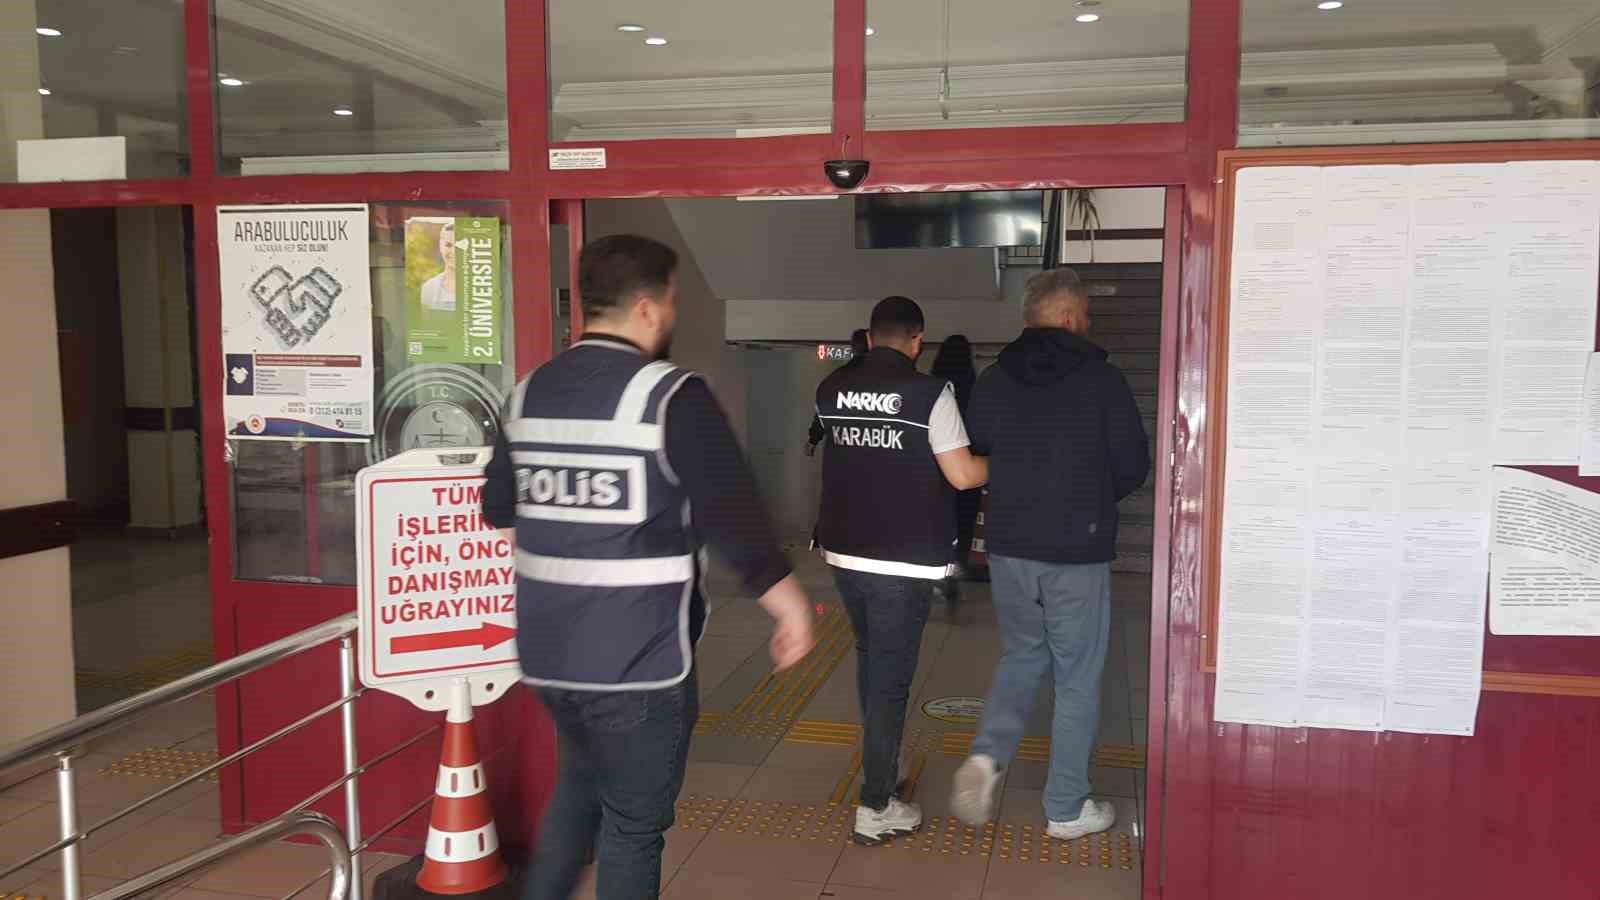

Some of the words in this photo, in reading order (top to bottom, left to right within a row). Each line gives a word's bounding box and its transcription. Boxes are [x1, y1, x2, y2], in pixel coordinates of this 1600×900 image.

[234, 220, 348, 242] ARABULUCULUK
[469, 238, 493, 337] ÜNİVERSİTE
[473, 339, 493, 357] 2.
[832, 425, 904, 450] KARABÜK
[432, 482, 485, 506] TÜM
[391, 540, 449, 571] İÇİN,
[459, 537, 515, 561] ÖNC
[387, 566, 517, 595] DANIŞMAY
[381, 594, 514, 624] UĞRAYINIZ
